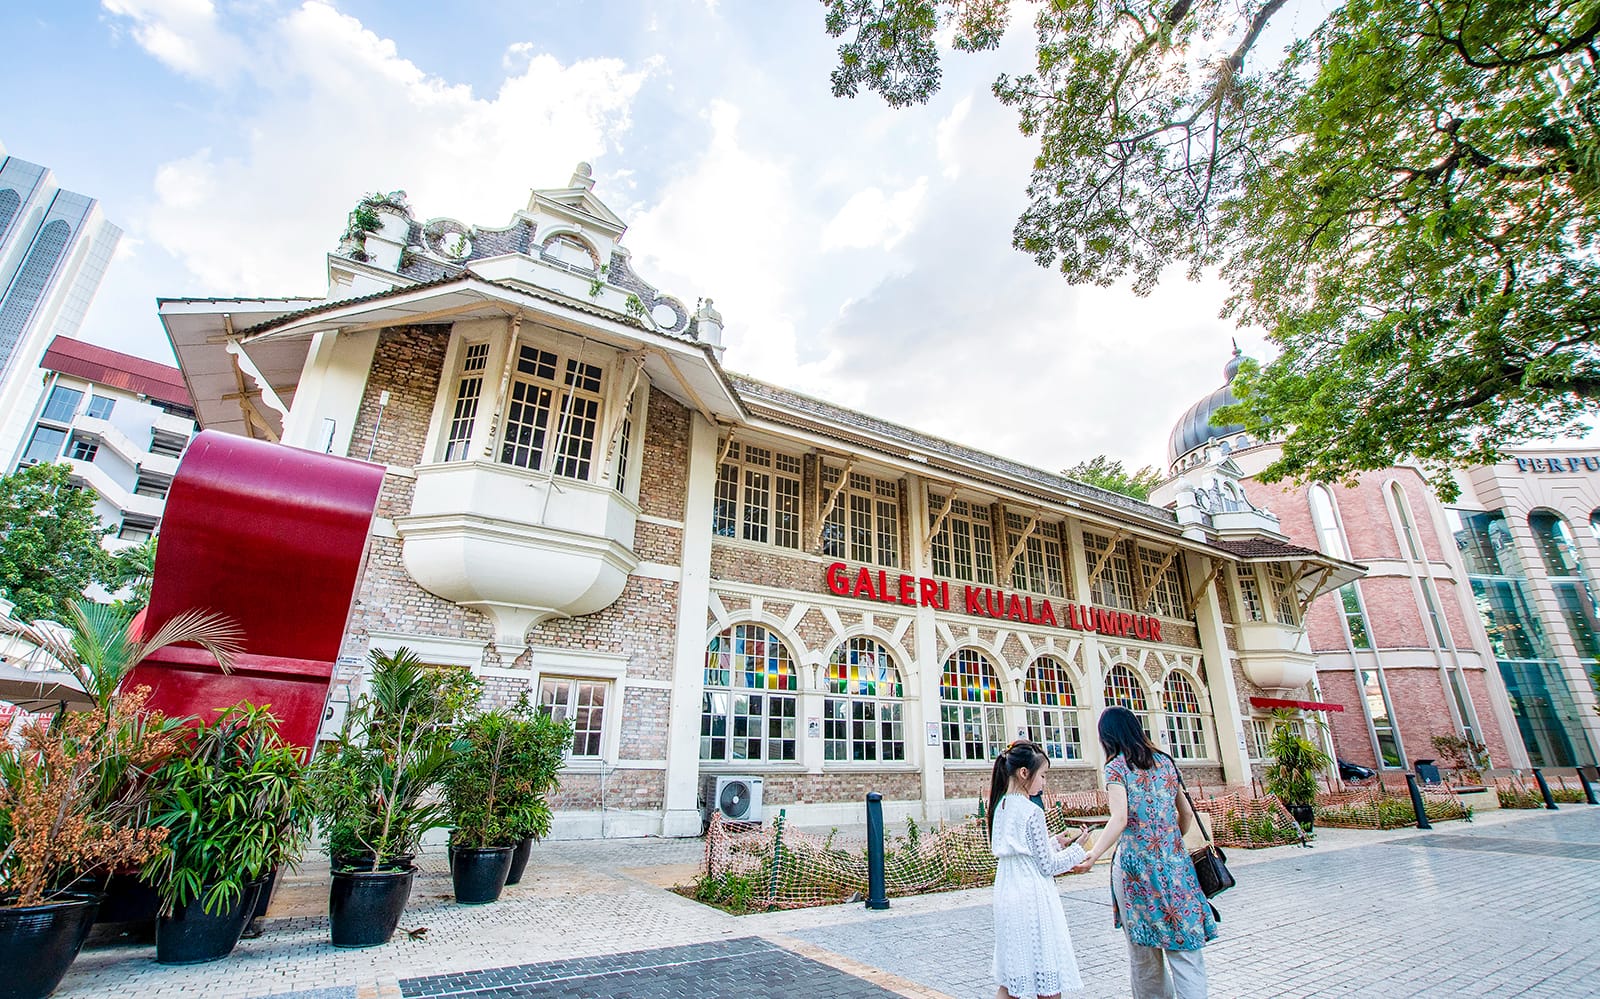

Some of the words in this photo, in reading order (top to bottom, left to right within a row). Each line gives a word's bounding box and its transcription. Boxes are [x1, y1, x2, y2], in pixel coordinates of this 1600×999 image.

[1515, 456, 1600, 473] PERPU
[826, 562, 950, 611] GALERI
[965, 585, 1058, 626] KUALA
[1069, 603, 1164, 642] LUMPUR
